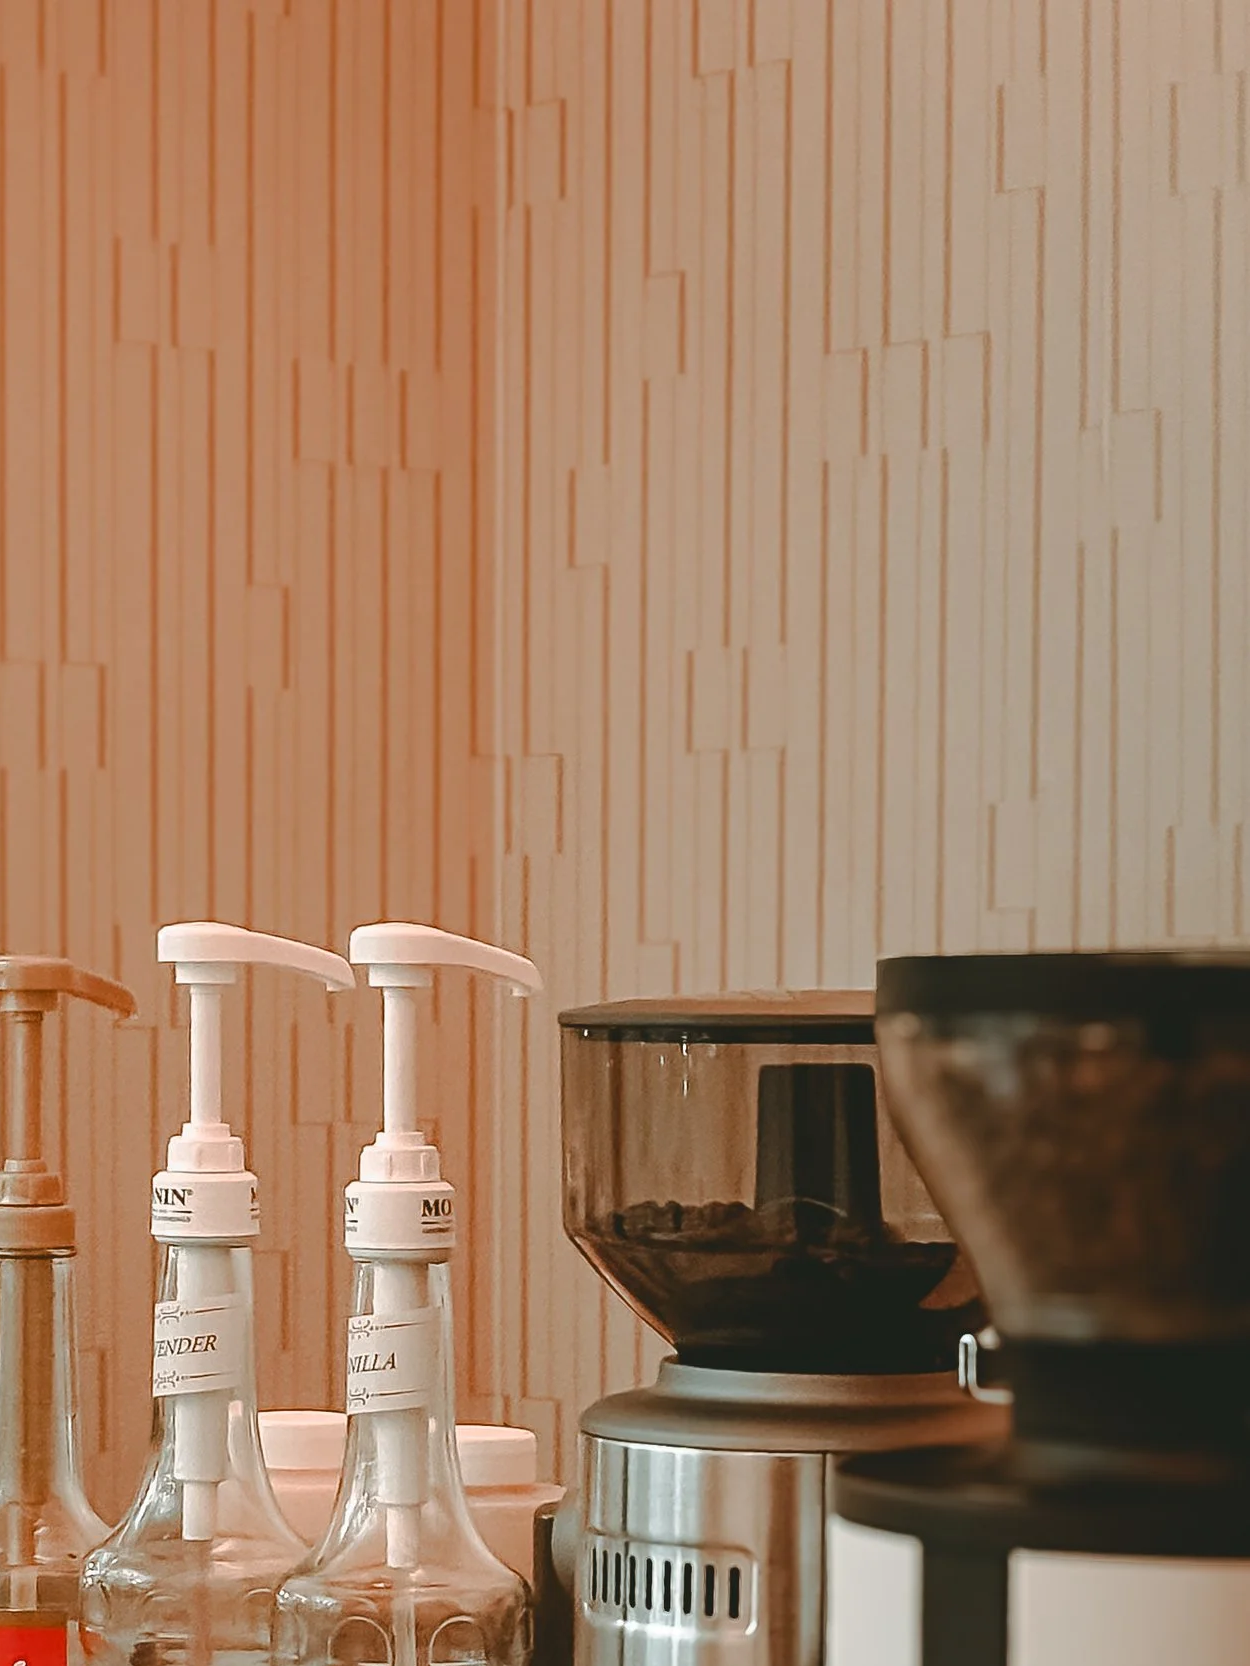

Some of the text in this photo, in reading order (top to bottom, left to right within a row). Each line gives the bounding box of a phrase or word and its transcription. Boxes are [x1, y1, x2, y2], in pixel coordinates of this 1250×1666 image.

[153, 1187, 187, 1206] NIN
[155, 1334, 217, 1357] ENDER
[348, 1352, 396, 1374] NILLA
